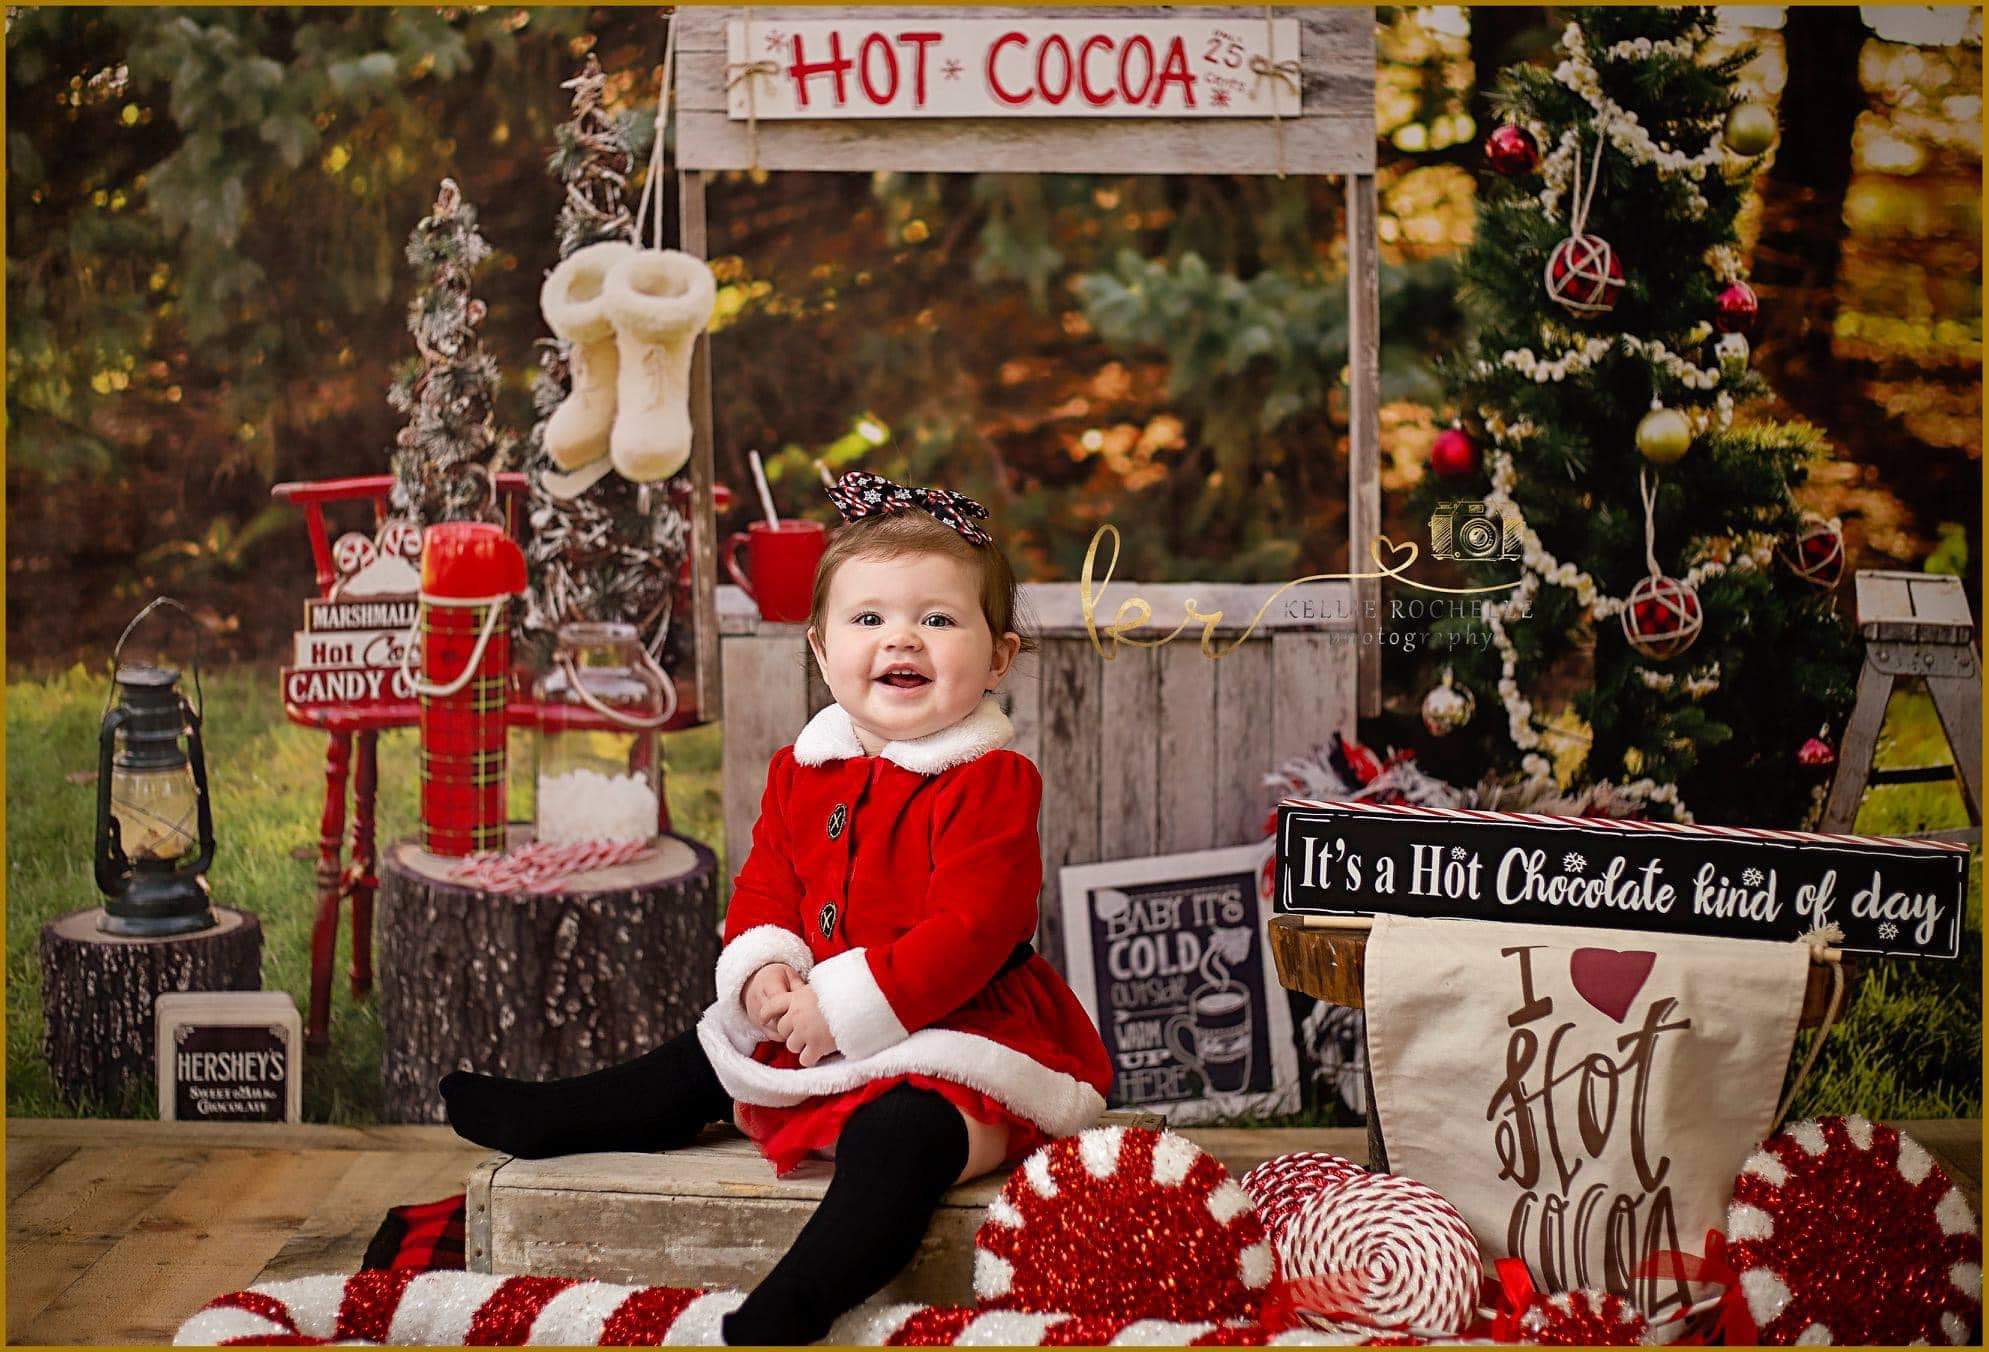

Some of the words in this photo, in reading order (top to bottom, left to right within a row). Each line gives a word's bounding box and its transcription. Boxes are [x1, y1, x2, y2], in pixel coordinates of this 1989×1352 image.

[786, 30, 943, 109] HOT
[985, 33, 1198, 109] COCOA
[1203, 38, 1244, 69] 25
[313, 603, 418, 629] MARSHMALL
[288, 670, 384, 702] CANDY
[1300, 836, 1362, 891] It's
[1374, 856, 1395, 894] a
[1408, 843, 1484, 901] Hot
[1496, 847, 1677, 914] Chocolate
[1693, 862, 1784, 923] kind
[1796, 869, 1837, 930] of
[1851, 870, 1947, 946] day
[1107, 897, 1182, 941] BABY
[1108, 931, 1201, 980] COLD
[1500, 944, 1553, 1028] I
[177, 1049, 284, 1082] HERSHEY'S
[1486, 997, 1691, 1197] Hot
